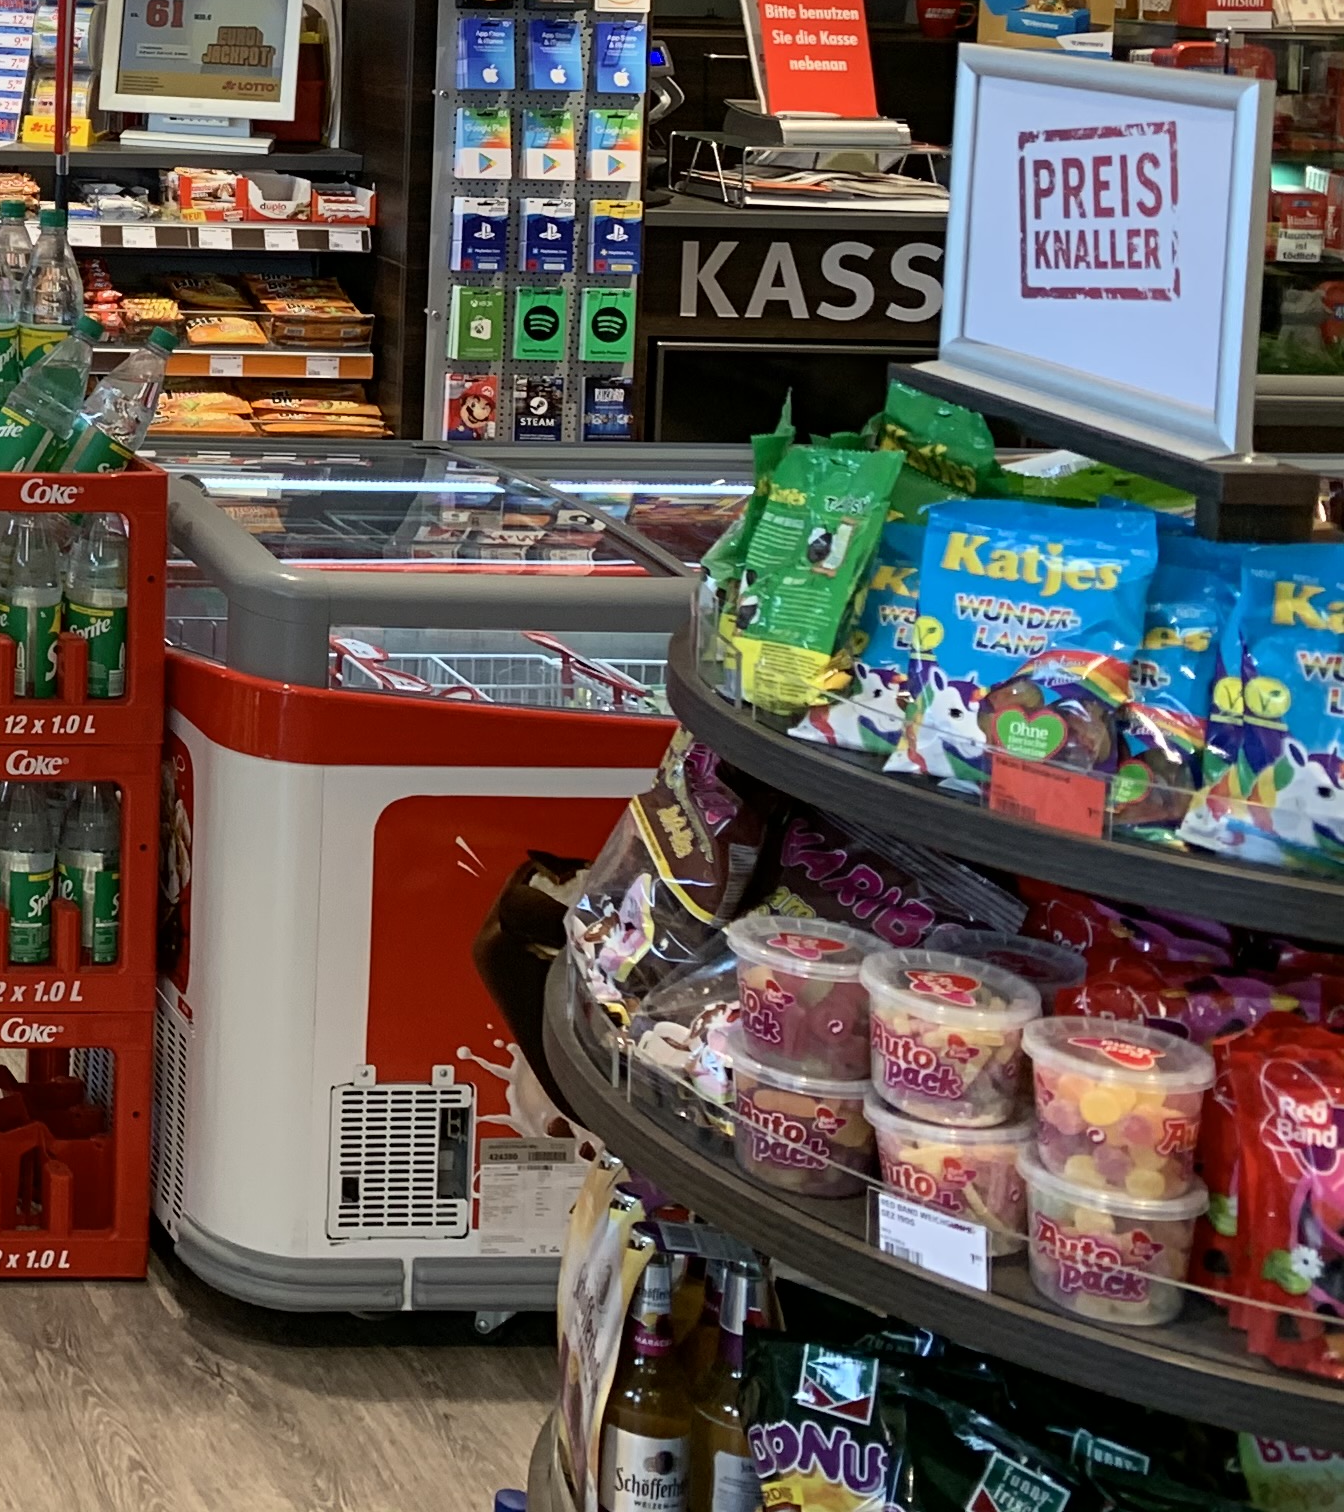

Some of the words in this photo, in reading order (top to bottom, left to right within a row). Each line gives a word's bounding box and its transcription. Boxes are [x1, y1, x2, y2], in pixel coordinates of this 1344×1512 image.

[765, 3, 797, 20] Bitte
[799, 4, 860, 21] benutzen
[217, 26, 259, 46] EURO
[771, 29, 793, 45] Sie
[795, 29, 817, 45] die
[819, 30, 858, 46] Kasse
[201, 44, 274, 67] JACKPOT
[789, 55, 848, 72] nebenan
[238, 82, 276, 93] LOTTO
[1033, 152, 1163, 220] PREIS
[260, 202, 287, 212] duplo
[1034, 228, 1162, 270] KNALLER
[679, 240, 943, 322] KASS
[520, 417, 555, 427] STEAM
[20, 478, 78, 504] Coke
[940, 531, 1122, 597] Katjes
[956, 594, 1081, 630] WUNDER-
[975, 626, 1047, 657] LAND
[4, 715, 27, 734] 12
[30, 719, 45, 734] x
[50, 715, 80, 734] 1.0
[84, 715, 96, 733] L
[1010, 722, 1049, 738] Ohne
[6, 750, 63, 775] Coke
[781, 818, 936, 948] HARIB
[10, 985, 24, 1002] x
[33, 981, 64, 1002] 1.0
[70, 981, 83, 1001] L
[0, 1017, 57, 1043] Coke
[871, 1017, 937, 1074] Auto
[886, 1058, 962, 1099] pack
[738, 1096, 807, 1146] Auto
[1277, 1095, 1330, 1124] Red
[1276, 1118, 1337, 1150] Band
[753, 1135, 830, 1170] pack
[1036, 1212, 1121, 1272] Auto
[7, 1253, 20, 1268] x
[26, 1250, 54, 1268] 1.0
[58, 1250, 70, 1268] L
[1060, 1263, 1148, 1301] pack
